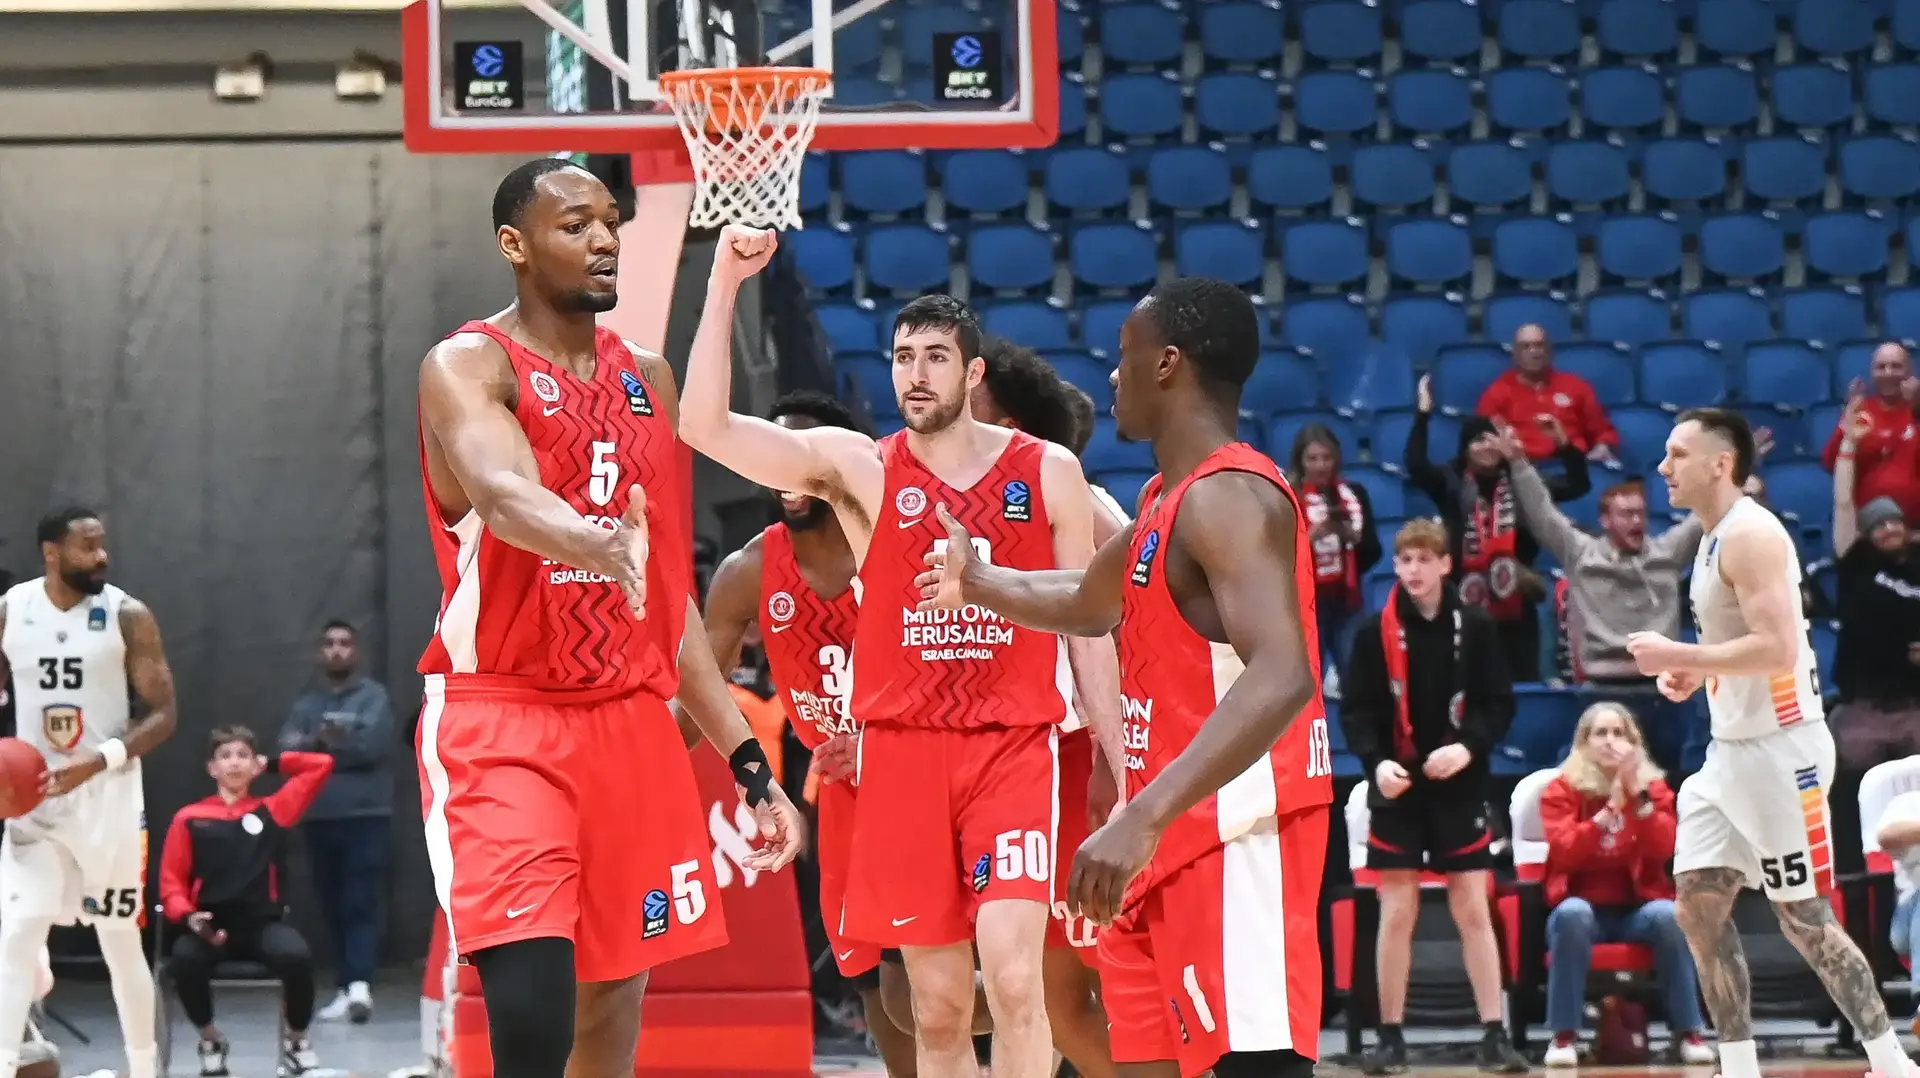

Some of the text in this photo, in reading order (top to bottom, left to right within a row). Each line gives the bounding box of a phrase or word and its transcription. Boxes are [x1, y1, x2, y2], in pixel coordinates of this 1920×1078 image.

[588, 440, 619, 507] 5
[901, 625, 1014, 647] JERUSALEM
[38, 656, 84, 690] 35
[994, 829, 1050, 883] 50
[1760, 850, 1808, 890] 55
[670, 858, 708, 925] 5
[1182, 963, 1216, 1034] 1
